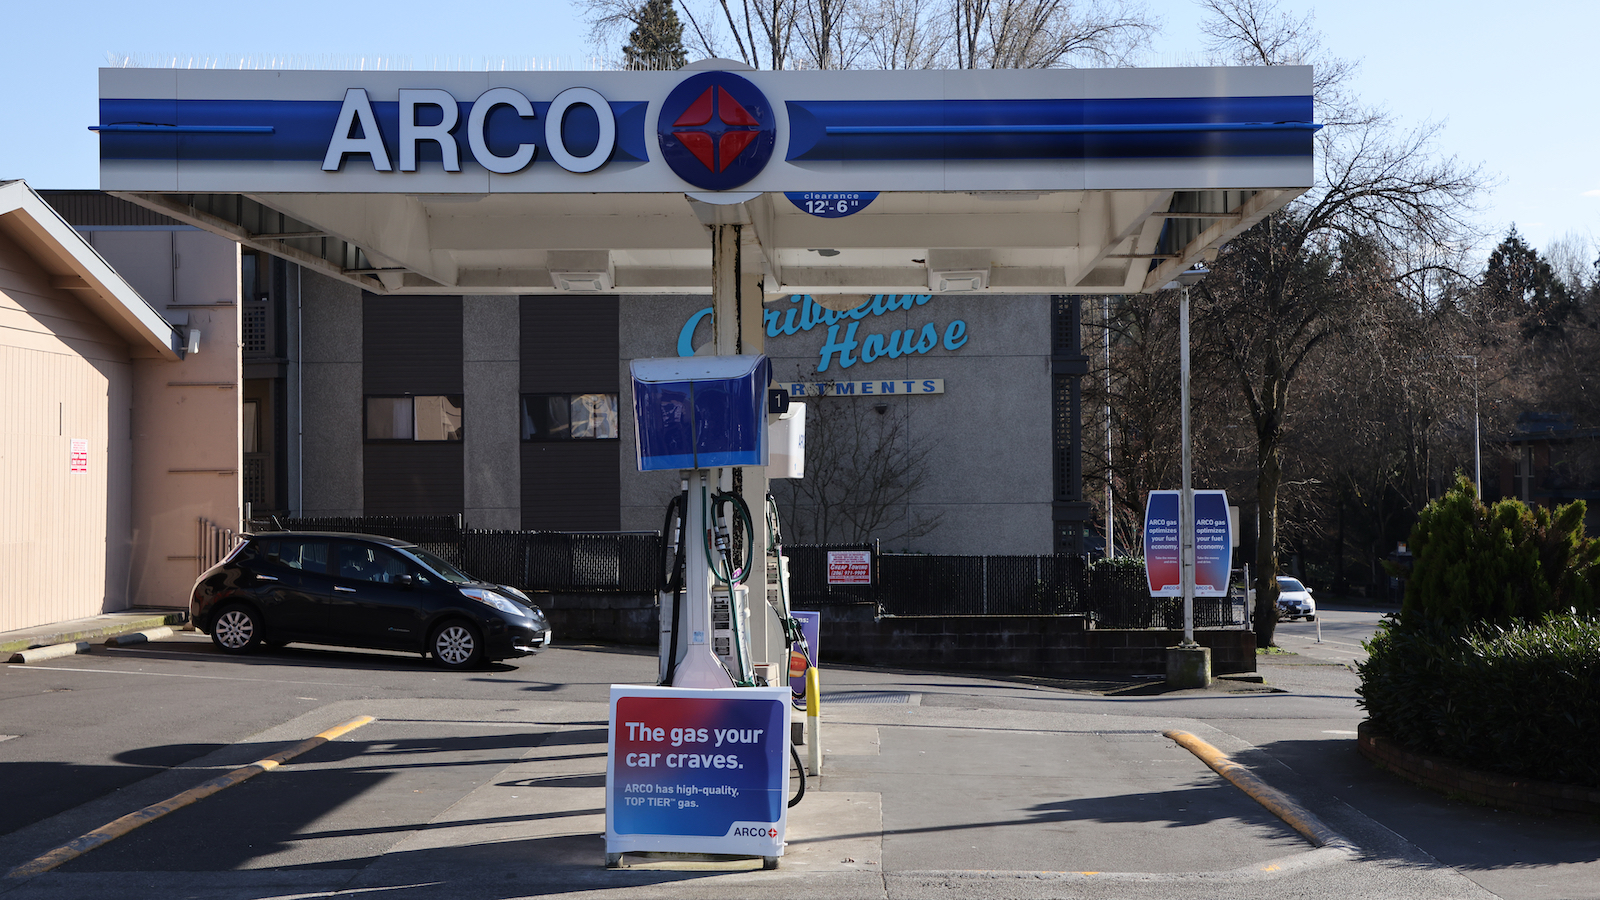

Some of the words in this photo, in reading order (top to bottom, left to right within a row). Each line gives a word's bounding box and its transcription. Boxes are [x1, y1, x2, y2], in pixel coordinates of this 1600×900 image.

[321, 86, 617, 174] ARCO
[817, 320, 968, 372] House
[775, 394, 781, 408] 1
[625, 721, 665, 742] The
[670, 728, 708, 747] gas
[714, 728, 764, 748] your
[625, 752, 661, 768] car
[666, 753, 744, 770] craves.
[625, 784, 653, 793] ARCO
[655, 784, 674, 794] has
[676, 785, 739, 798] high-quality,
[625, 797, 645, 806] TOP
[678, 800, 699, 809] gas.
[733, 827, 766, 837] ARCO
